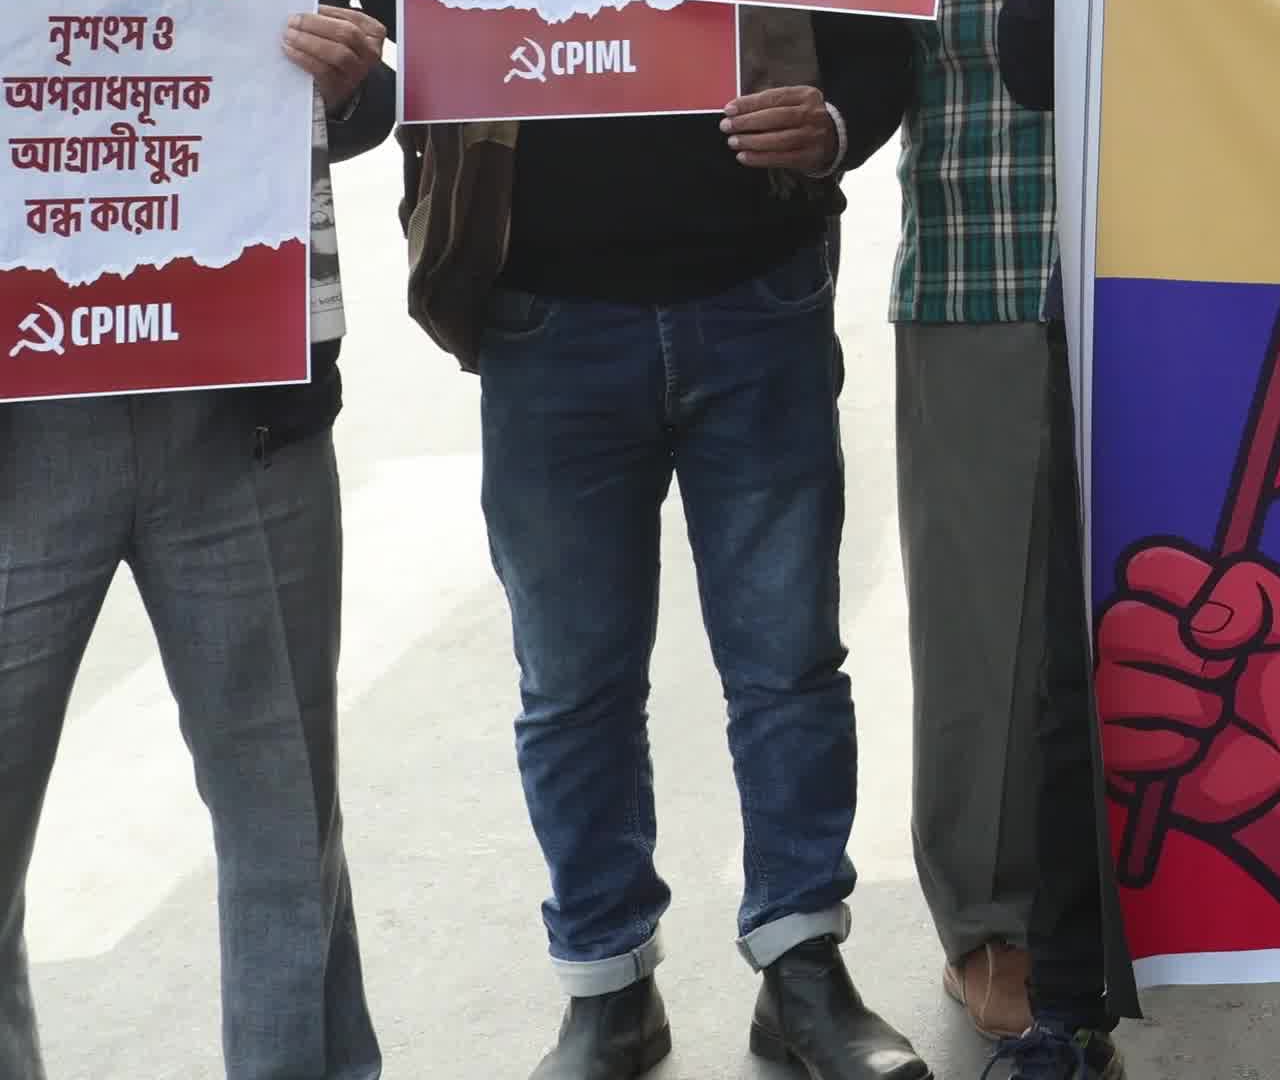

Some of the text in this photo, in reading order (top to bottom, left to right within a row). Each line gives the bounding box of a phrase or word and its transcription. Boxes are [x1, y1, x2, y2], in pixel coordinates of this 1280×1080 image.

[48, 16, 174, 66] নৃশংস ও
[550, 39, 636, 76] CPIML
[2, 76, 212, 125] অপরাধমূলক
[9, 122, 202, 184] আগ্রাসী যুদ্ধ
[25, 199, 84, 238] বন্ধ
[71, 303, 179, 346] CPIML
